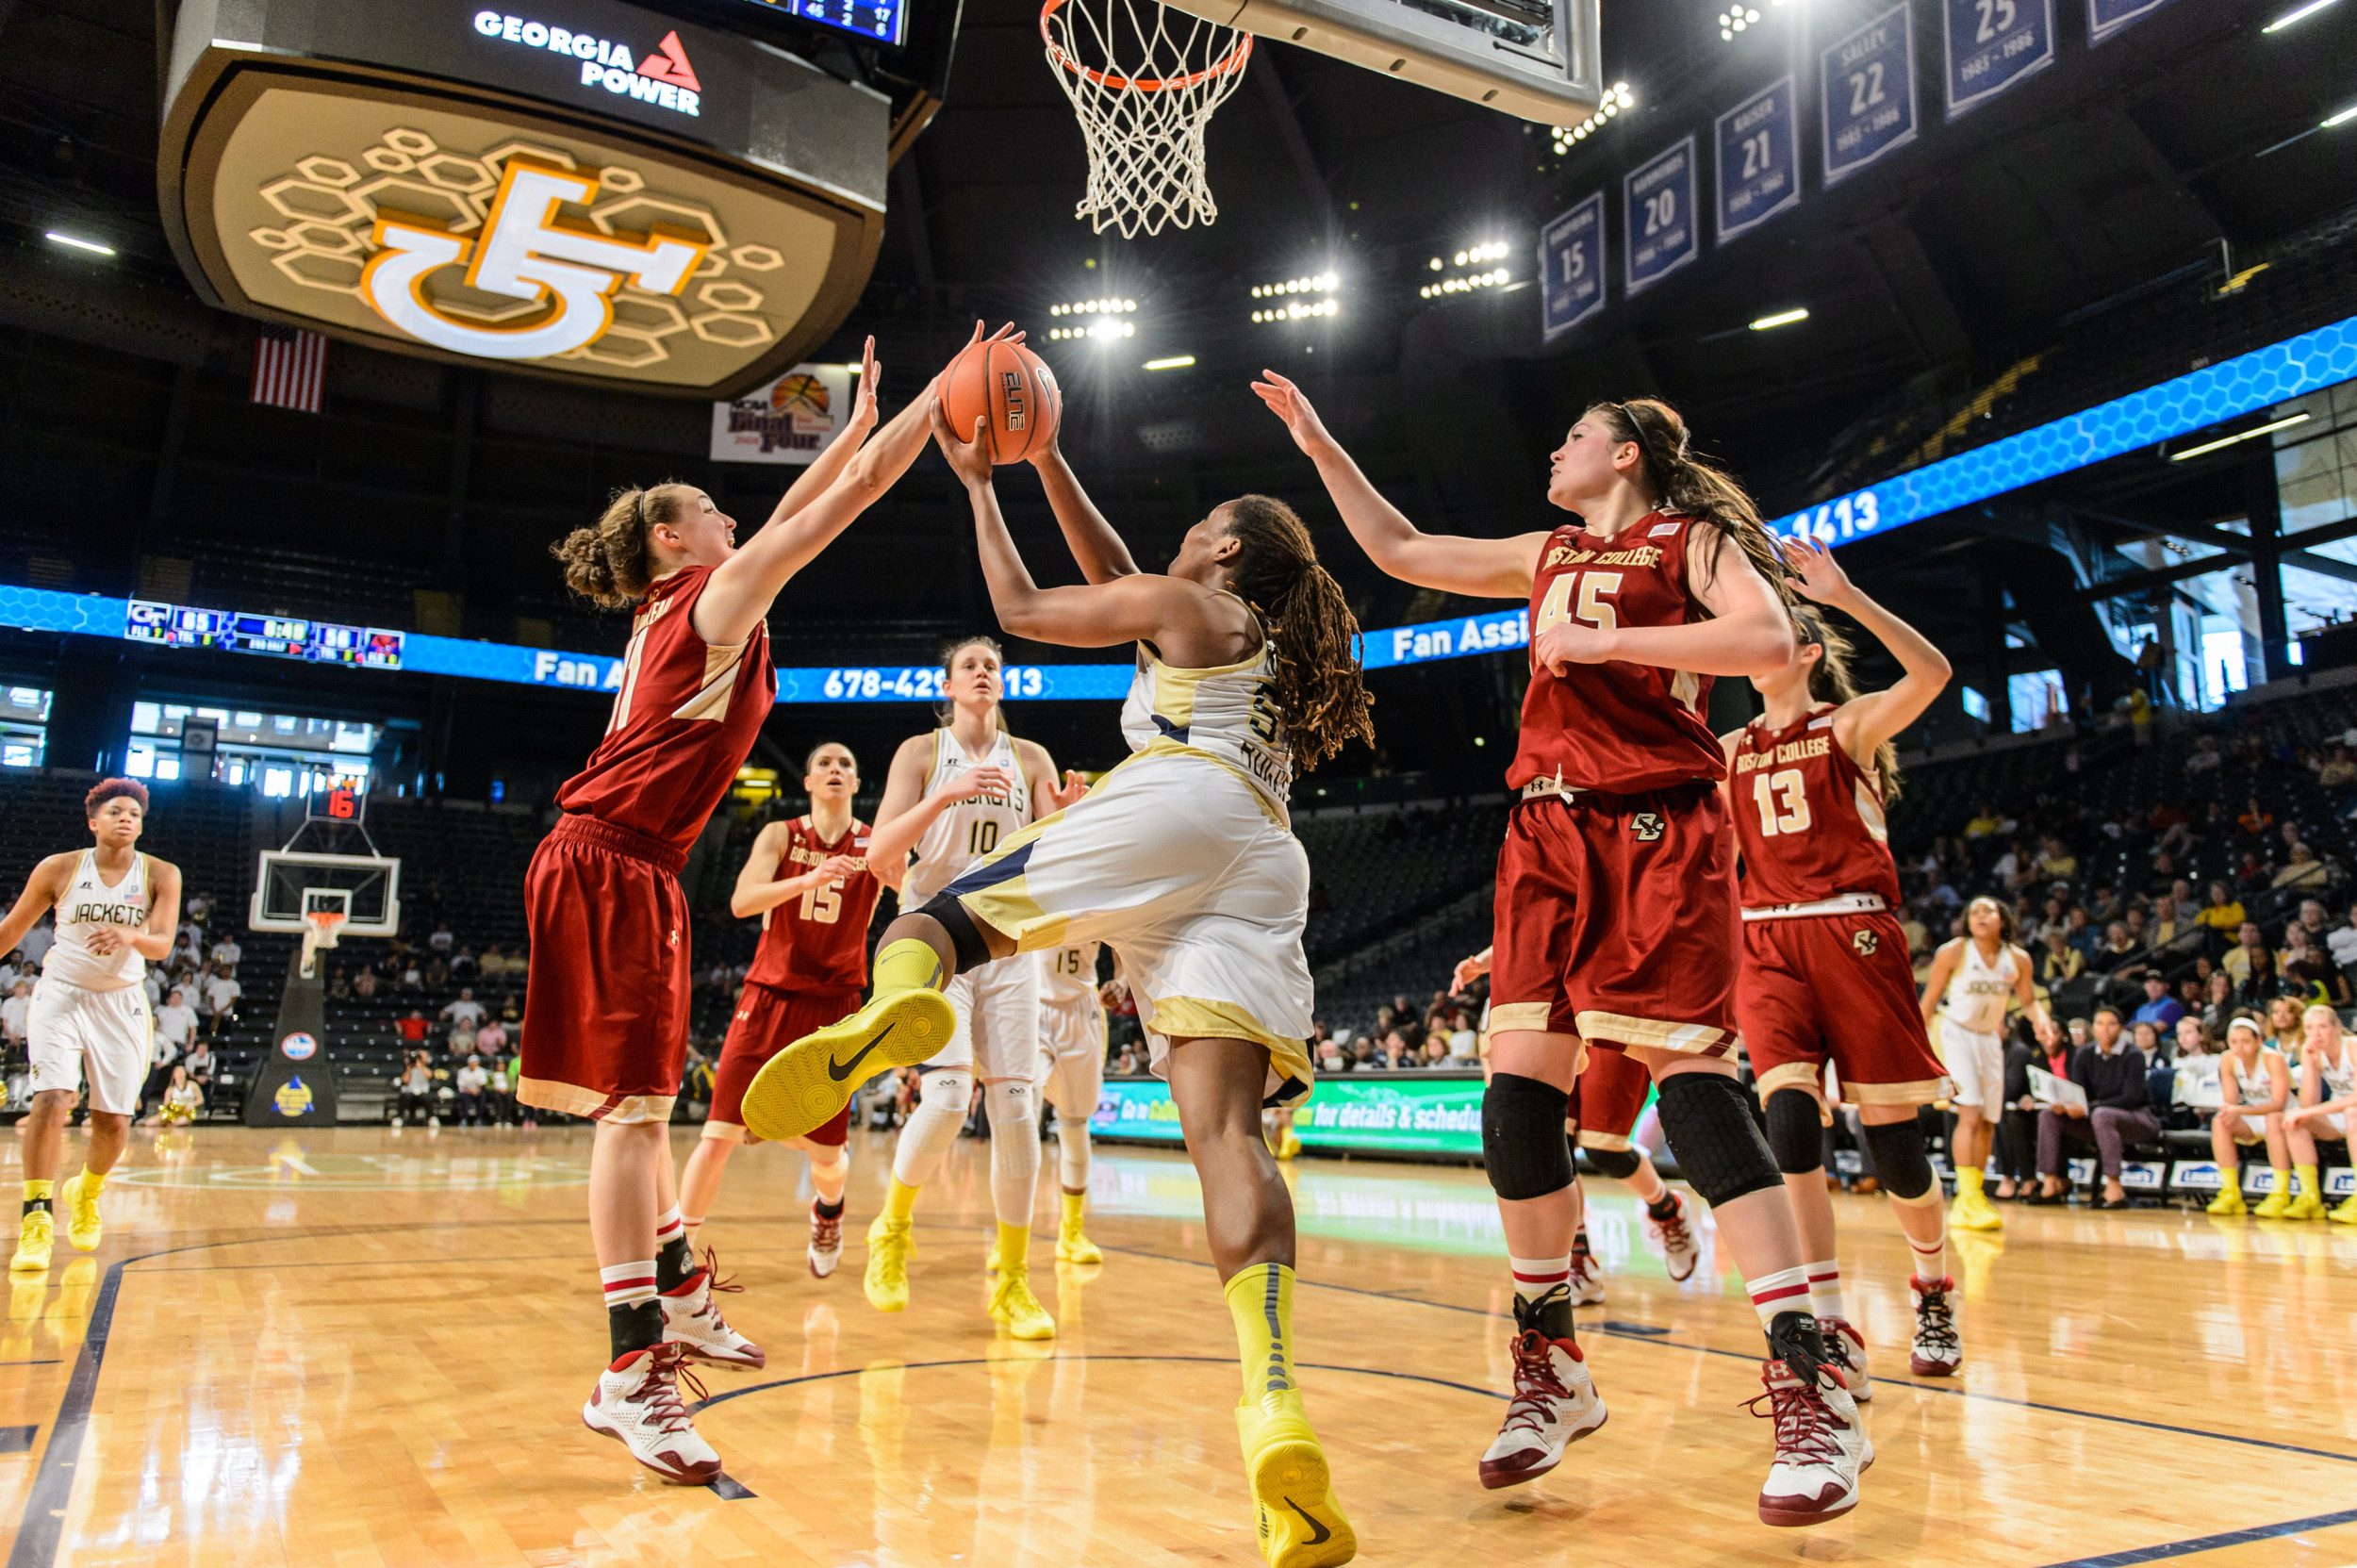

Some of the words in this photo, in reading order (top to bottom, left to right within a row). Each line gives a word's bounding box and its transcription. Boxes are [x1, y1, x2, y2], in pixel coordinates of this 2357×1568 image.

[473, 10, 635, 73] GEORGIA
[1975, 0, 2016, 43] 25
[580, 59, 700, 117] POWER
[1849, 61, 1885, 116] 22
[1741, 129, 1771, 180] 21
[1644, 189, 1675, 236] 20
[1560, 239, 1586, 284] 15
[1004, 371, 1026, 432] ELITE
[1591, 545, 1664, 569] COLLEGE
[1534, 570, 1624, 636] 45
[1393, 629, 1452, 662] Fan
[534, 650, 599, 687] Fan
[1736, 749, 1774, 775] BOSTON
[1775, 735, 1831, 765] COLLEGE
[329, 790, 354, 818] 16
[1753, 767, 1812, 837] 13
[968, 818, 999, 855] 10
[70, 903, 144, 928] JACKETS
[799, 871, 846, 925] 15
[1056, 949, 1080, 974] 15
[1313, 1100, 1338, 1128] for
[1338, 1100, 1398, 1130] details
[1396, 1104, 1412, 1130] &
